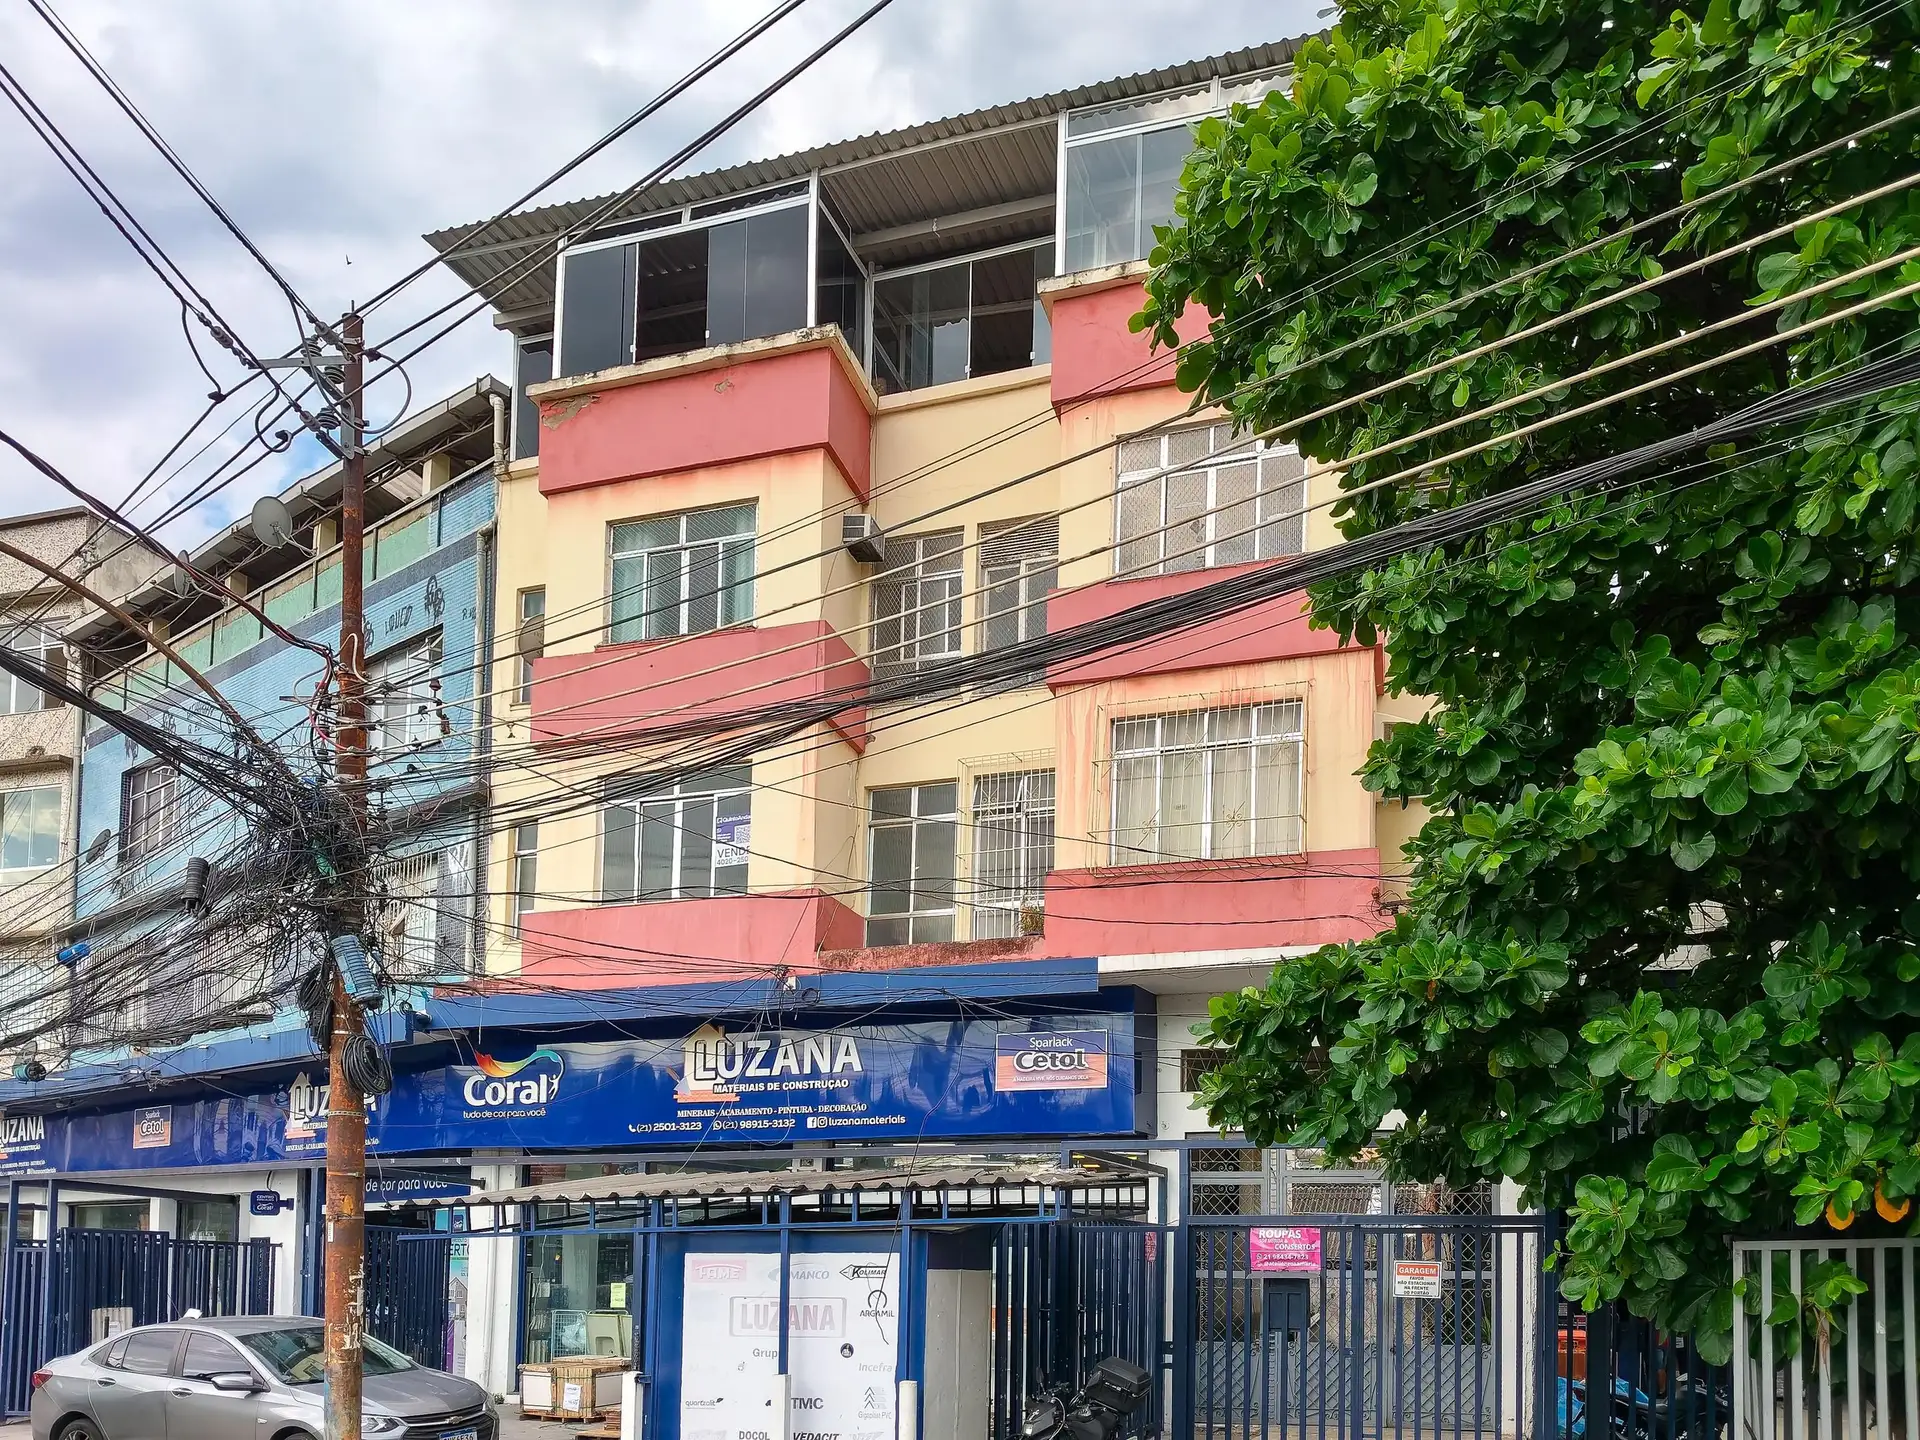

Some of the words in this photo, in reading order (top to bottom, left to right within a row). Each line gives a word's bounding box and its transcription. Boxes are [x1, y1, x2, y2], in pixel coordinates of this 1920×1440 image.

[1029, 1036, 1073, 1051] Sparlack
[695, 1036, 863, 1080] LUZANA
[1014, 1049, 1088, 1072] Cetol
[463, 1073, 548, 1107] Coral
[714, 1084, 765, 1093] MATERIAIS
[767, 1082, 780, 1090] DE
[294, 1085, 377, 1120] LUZA
[506, 1110, 526, 1119] para
[526, 1108, 547, 1117] você
[677, 1109, 715, 1118] MINERAIS
[720, 1107, 772, 1117] ACABAMENTO
[779, 1105, 813, 1115] PINTURA
[818, 1102, 867, 1114] DECORAÇÃO
[140, 1119, 164, 1135] Cetol
[653, 1121, 702, 1132] 2501-3123
[739, 1118, 796, 1129] 98915-3132
[828, 1115, 906, 1127] luzanamateriais
[0, 1116, 45, 1147] UZANA
[365, 1179, 378, 1192] de
[380, 1180, 396, 1191] cor
[397, 1179, 420, 1193] para
[1258, 1230, 1302, 1239] ROUPAS
[1398, 1267, 1437, 1275] GARAGEM
[858, 1362, 893, 1373] Incefra
[790, 1397, 824, 1410] TMC
[738, 1430, 771, 1440] DOCOL
[792, 1432, 839, 1440] VEDACIT
